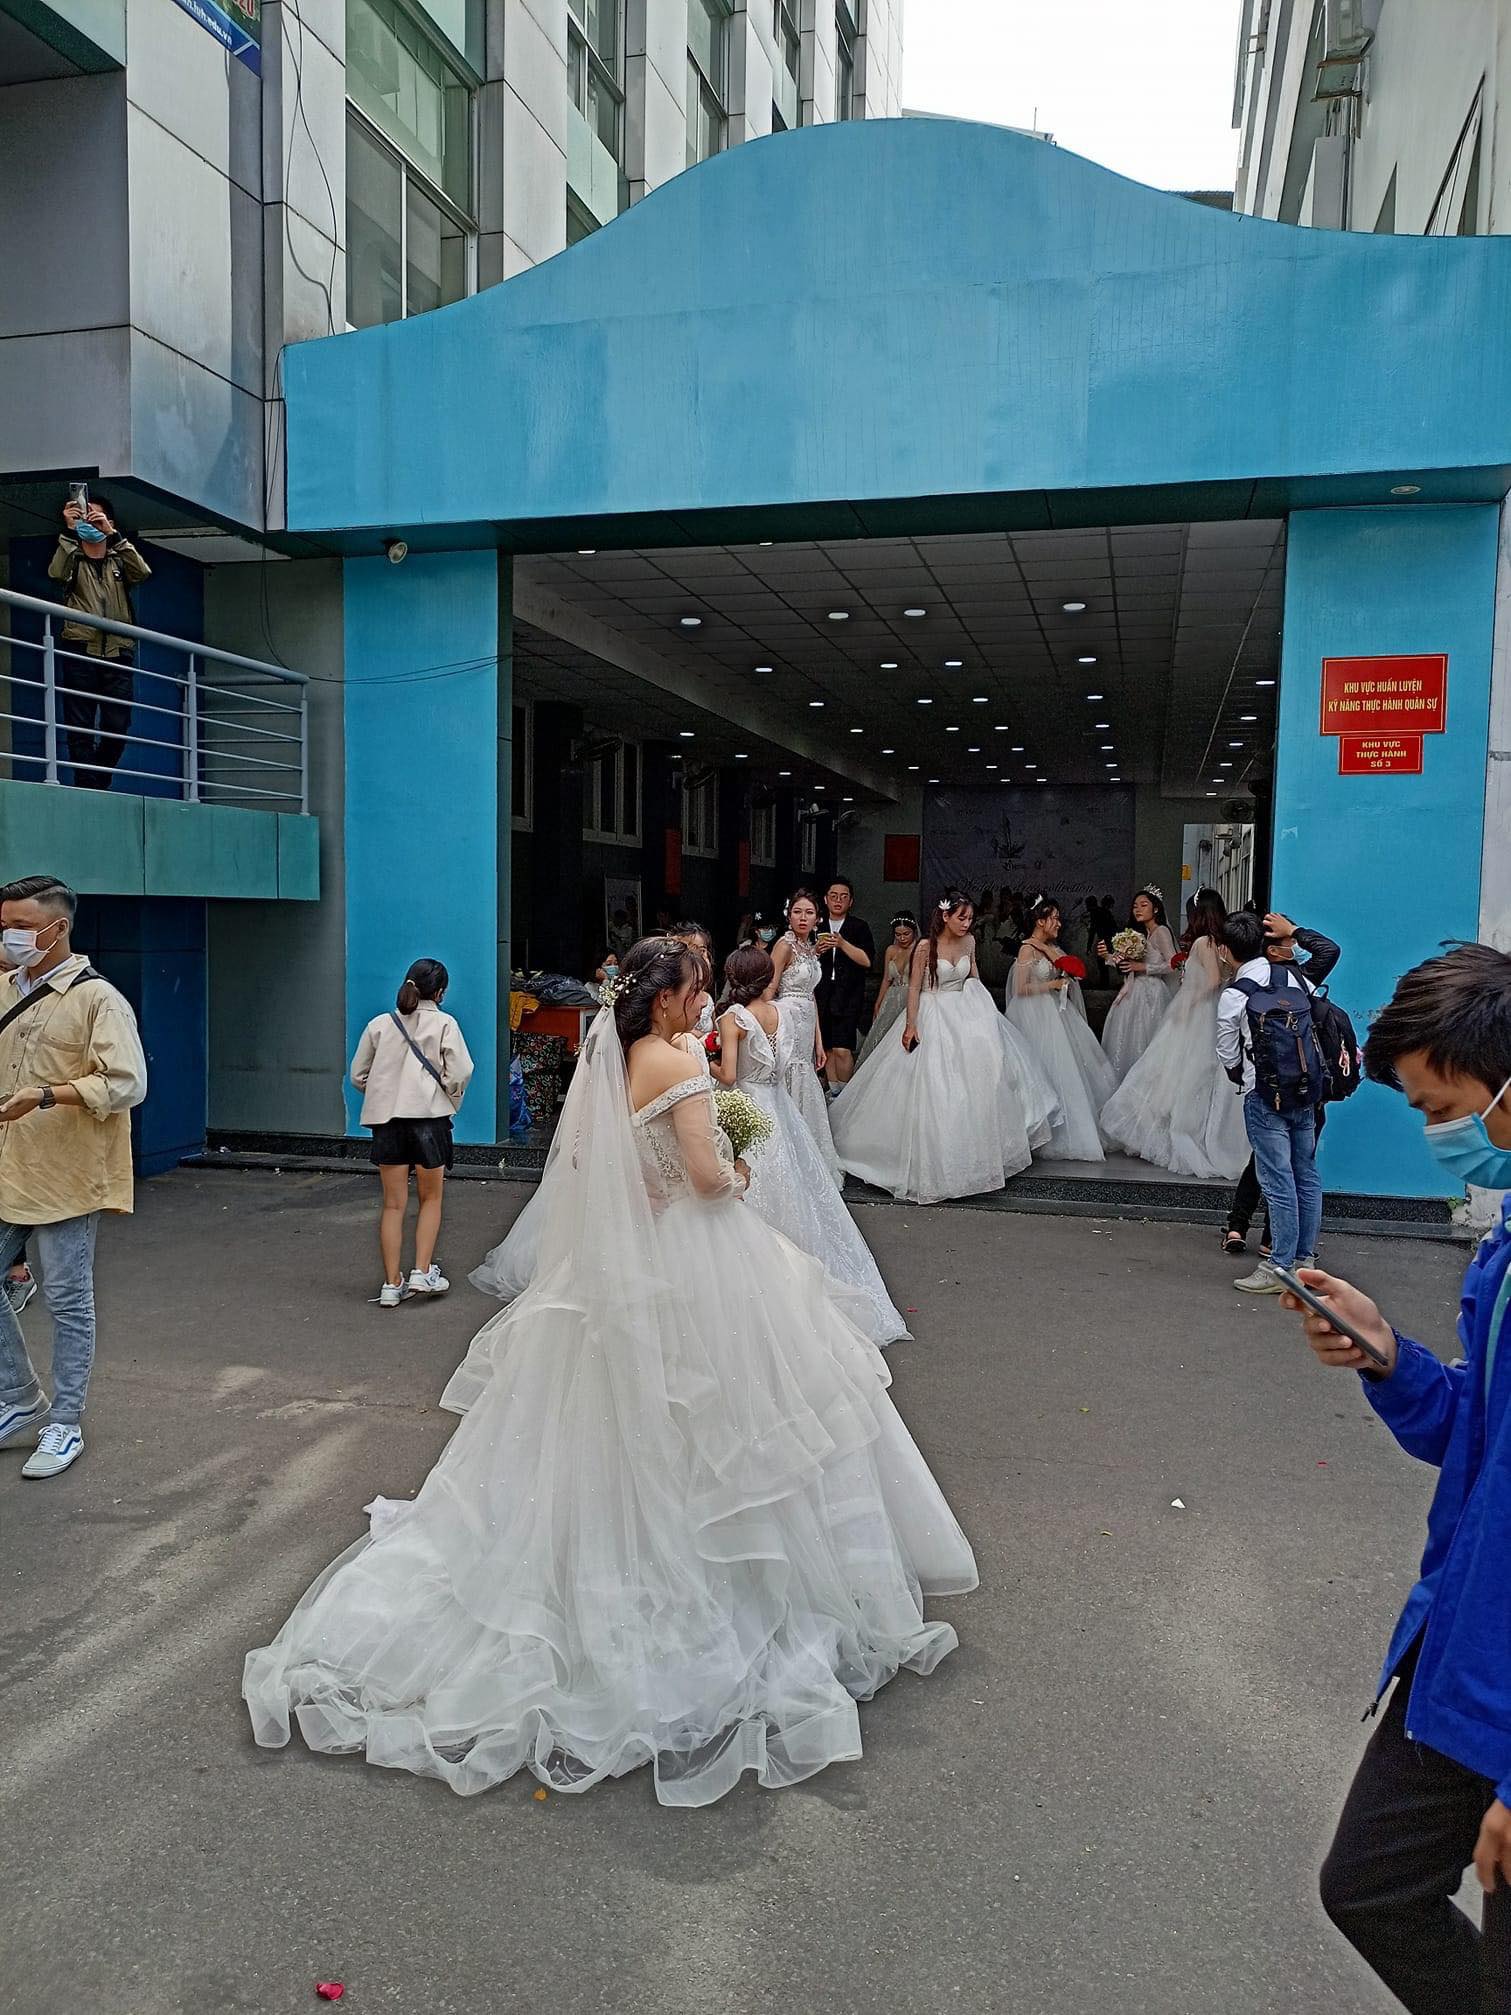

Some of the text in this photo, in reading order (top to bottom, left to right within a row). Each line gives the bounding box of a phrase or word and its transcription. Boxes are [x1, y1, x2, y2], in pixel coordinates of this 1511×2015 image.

[1344, 677, 1422, 695] KHU VỰC HUẤN LUYỆN
[1340, 698, 1361, 712] NĂNG
[1362, 699, 1381, 713] THỰC
[1382, 697, 1403, 711] HÀNH
[1405, 696, 1425, 711] QUÂN
[1427, 697, 1438, 712] SỰ
[1383, 740, 1401, 749] VỰC
[1356, 750, 1407, 760] THỰC HÀNH
[1370, 758, 1383, 768] SỐ
